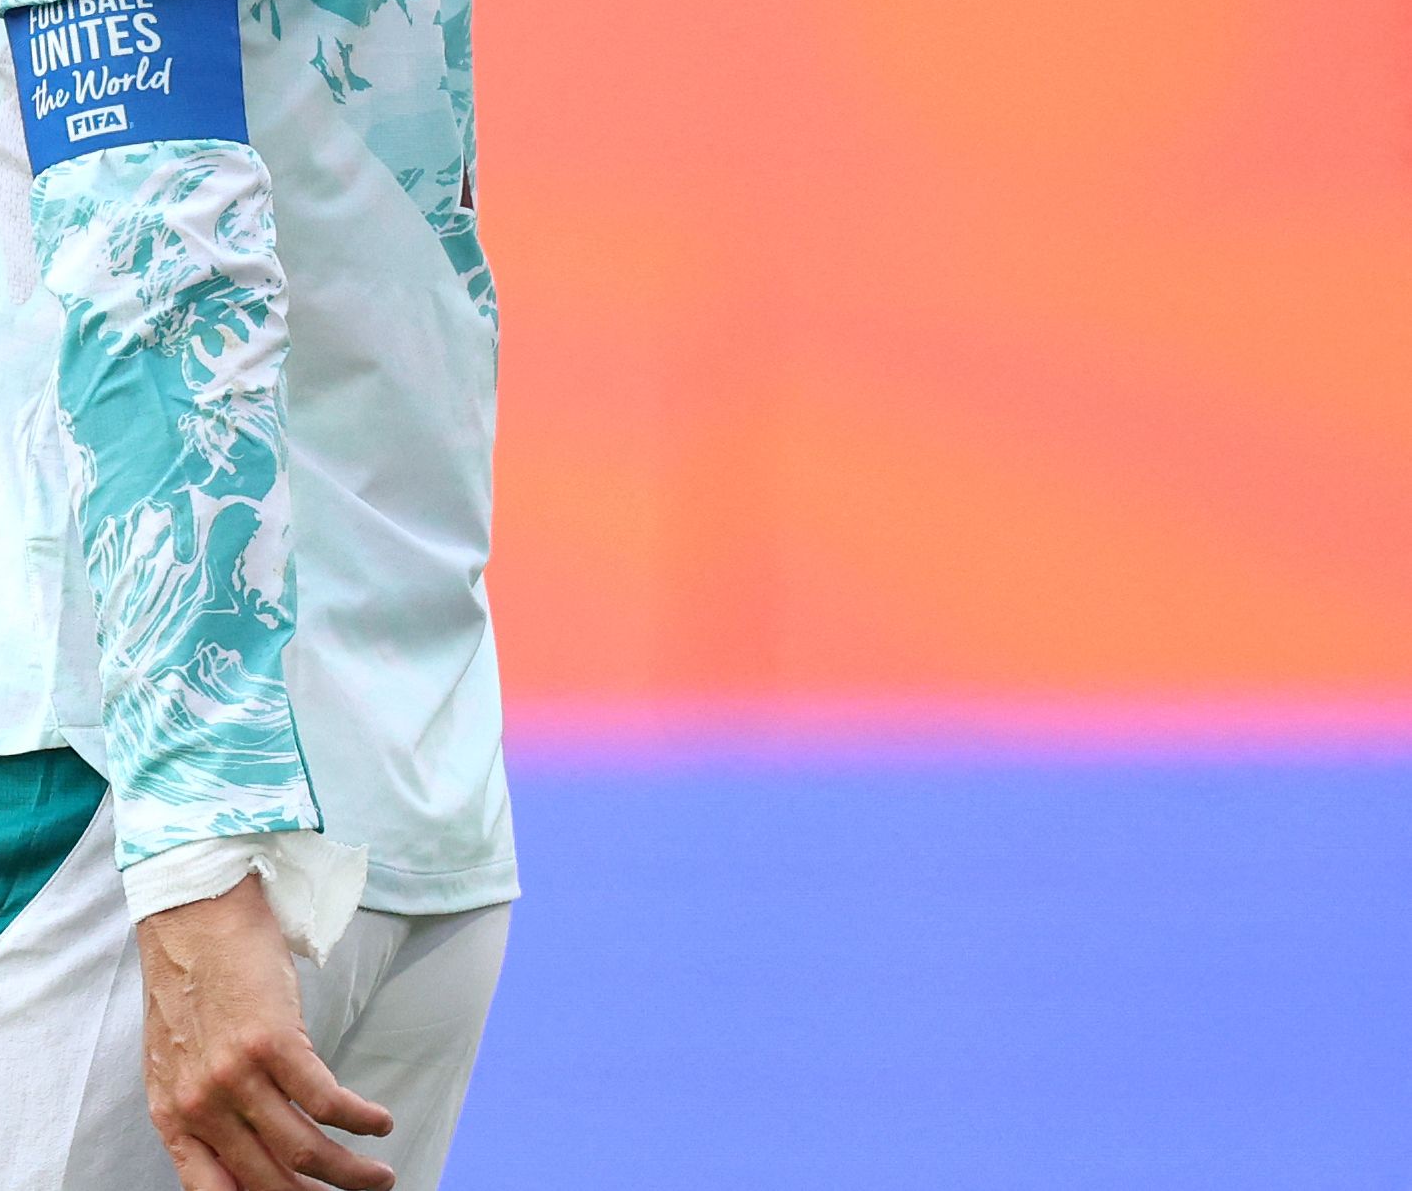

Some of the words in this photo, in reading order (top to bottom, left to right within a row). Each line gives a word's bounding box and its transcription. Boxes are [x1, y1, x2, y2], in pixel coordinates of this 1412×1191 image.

[30, 12, 163, 77] UNITES
[31, 79, 70, 120] the
[72, 56, 173, 104] World
[72, 110, 121, 136] FIFA
